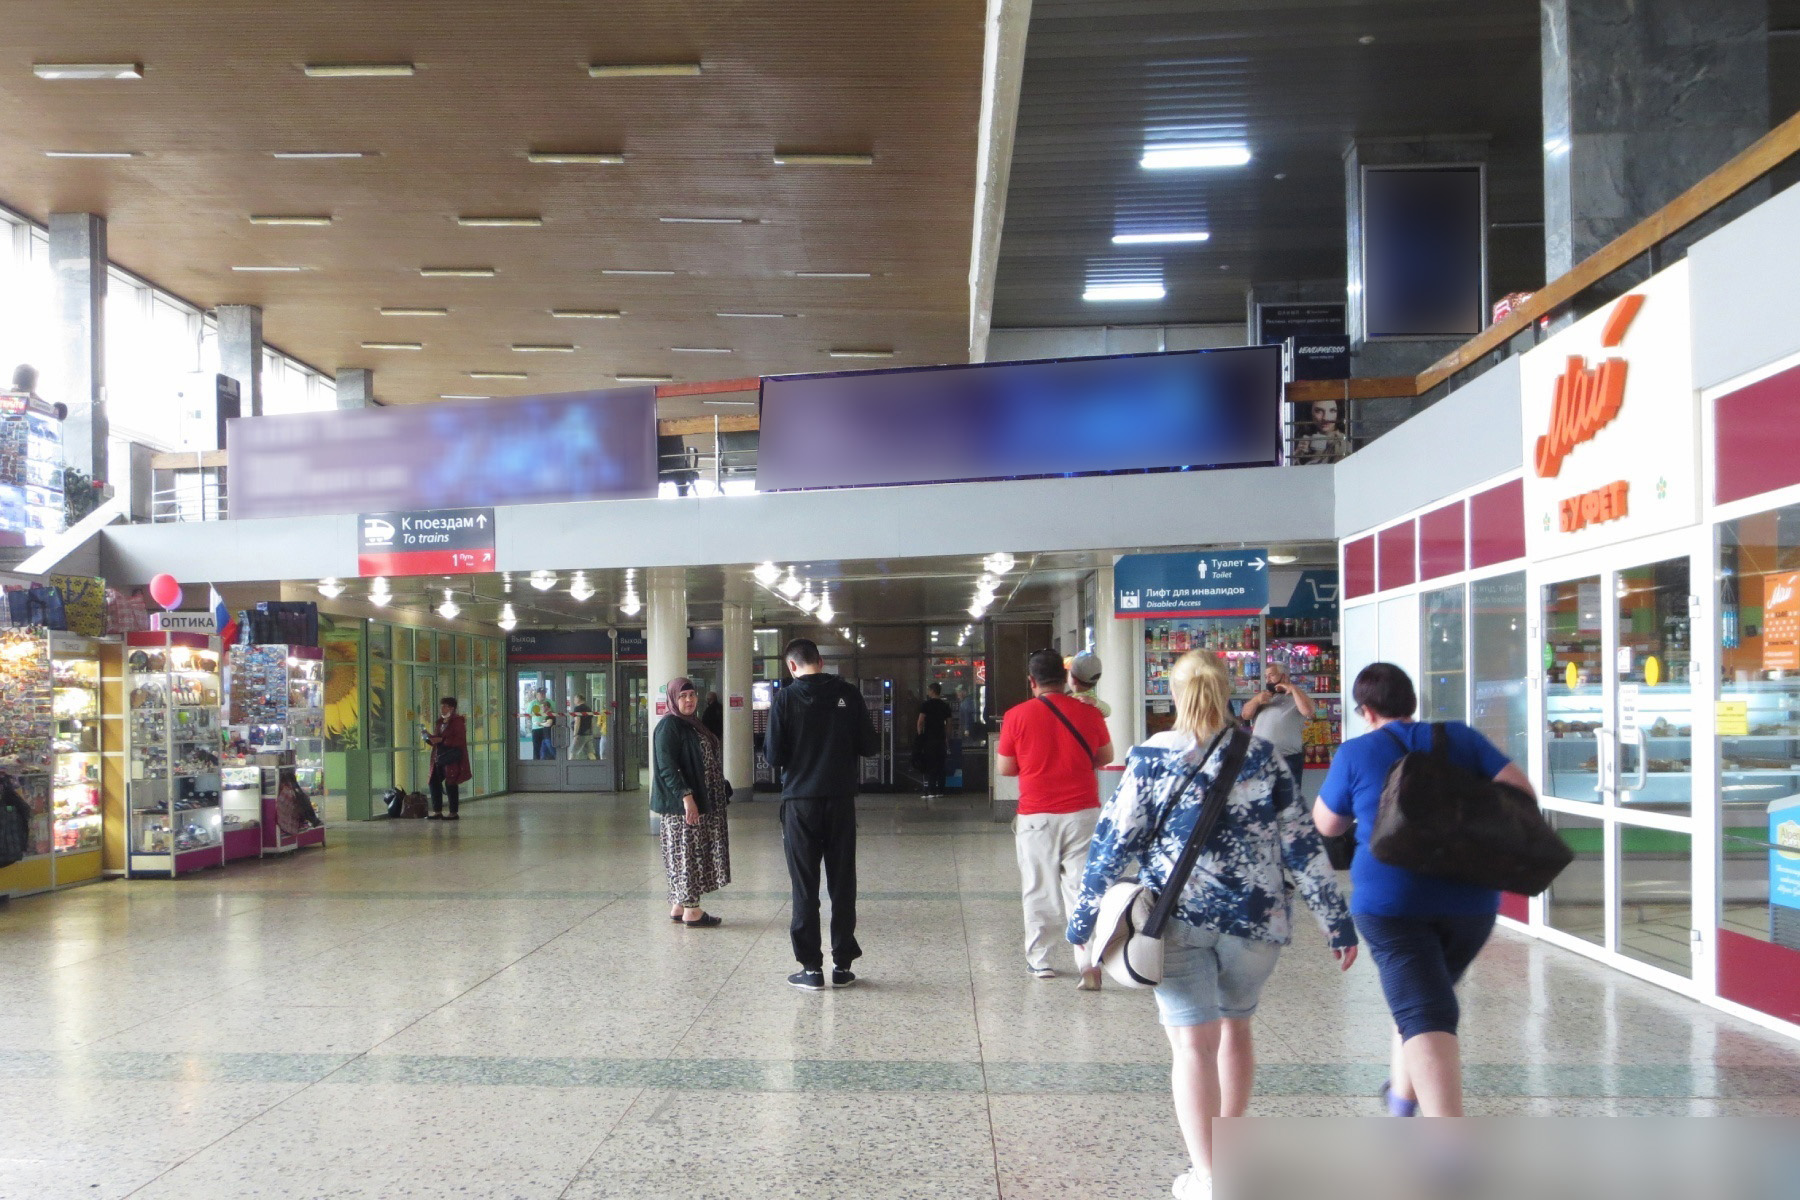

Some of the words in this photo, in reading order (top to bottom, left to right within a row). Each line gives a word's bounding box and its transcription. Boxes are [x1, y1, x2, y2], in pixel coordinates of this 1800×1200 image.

[1558, 479, 1630, 533] БУФЕТ
[401, 517, 412, 531] К
[414, 516, 474, 531] поездам
[403, 533, 416, 544] To
[418, 532, 450, 544] trains
[452, 553, 459, 567] 1
[459, 553, 474, 561] Путь
[1211, 558, 1244, 570] Туалет
[1212, 571, 1233, 579] Toilet
[1145, 588, 1171, 599] Лифт
[1172, 588, 1190, 598] для
[1191, 586, 1246, 596] инвалидов
[1146, 600, 1178, 608] Disabled
[1179, 599, 1201, 607] Access
[161, 617, 215, 628] ОПТИКА
[511, 635, 536, 644] Выход
[620, 637, 642, 645] Выход
